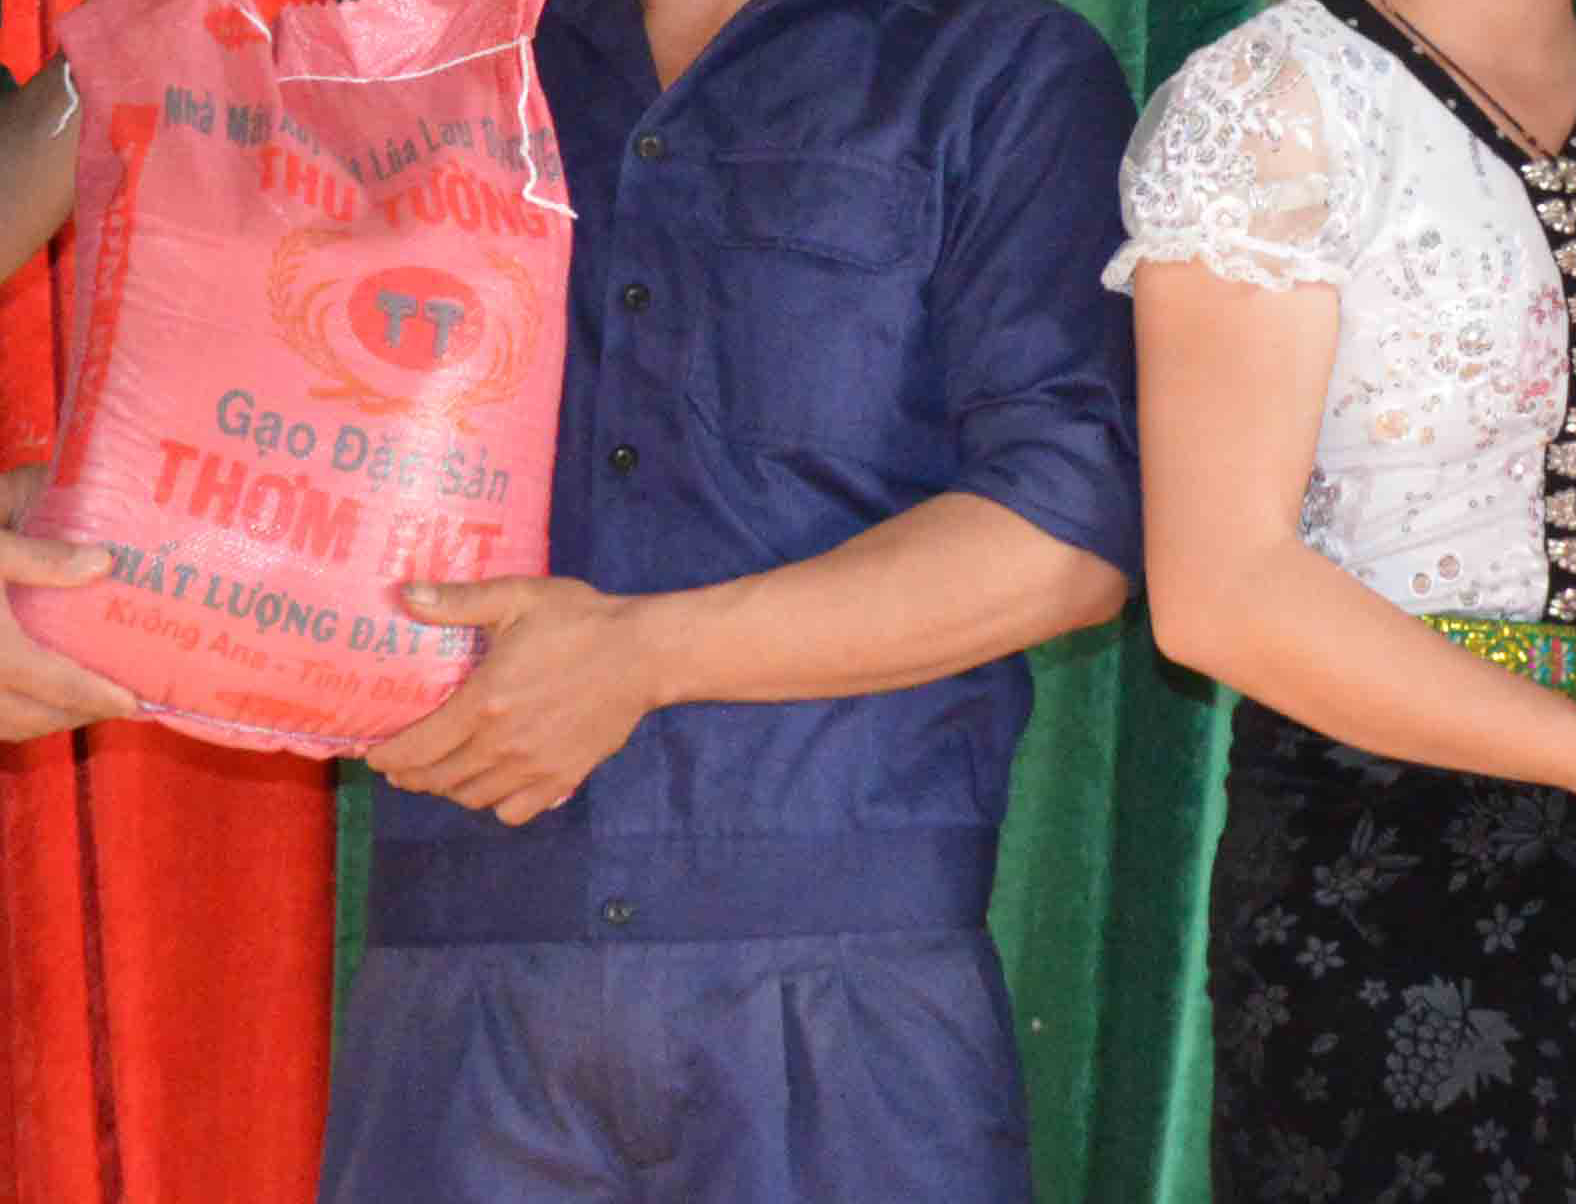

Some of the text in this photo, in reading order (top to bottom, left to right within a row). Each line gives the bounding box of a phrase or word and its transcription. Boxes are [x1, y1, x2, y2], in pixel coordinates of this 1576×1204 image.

[152, 439, 365, 565] THƠM
[215, 389, 510, 504] Gạo Đặc Sản
[108, 538, 200, 600] HẤT
[202, 570, 339, 644] LƯỢNG
